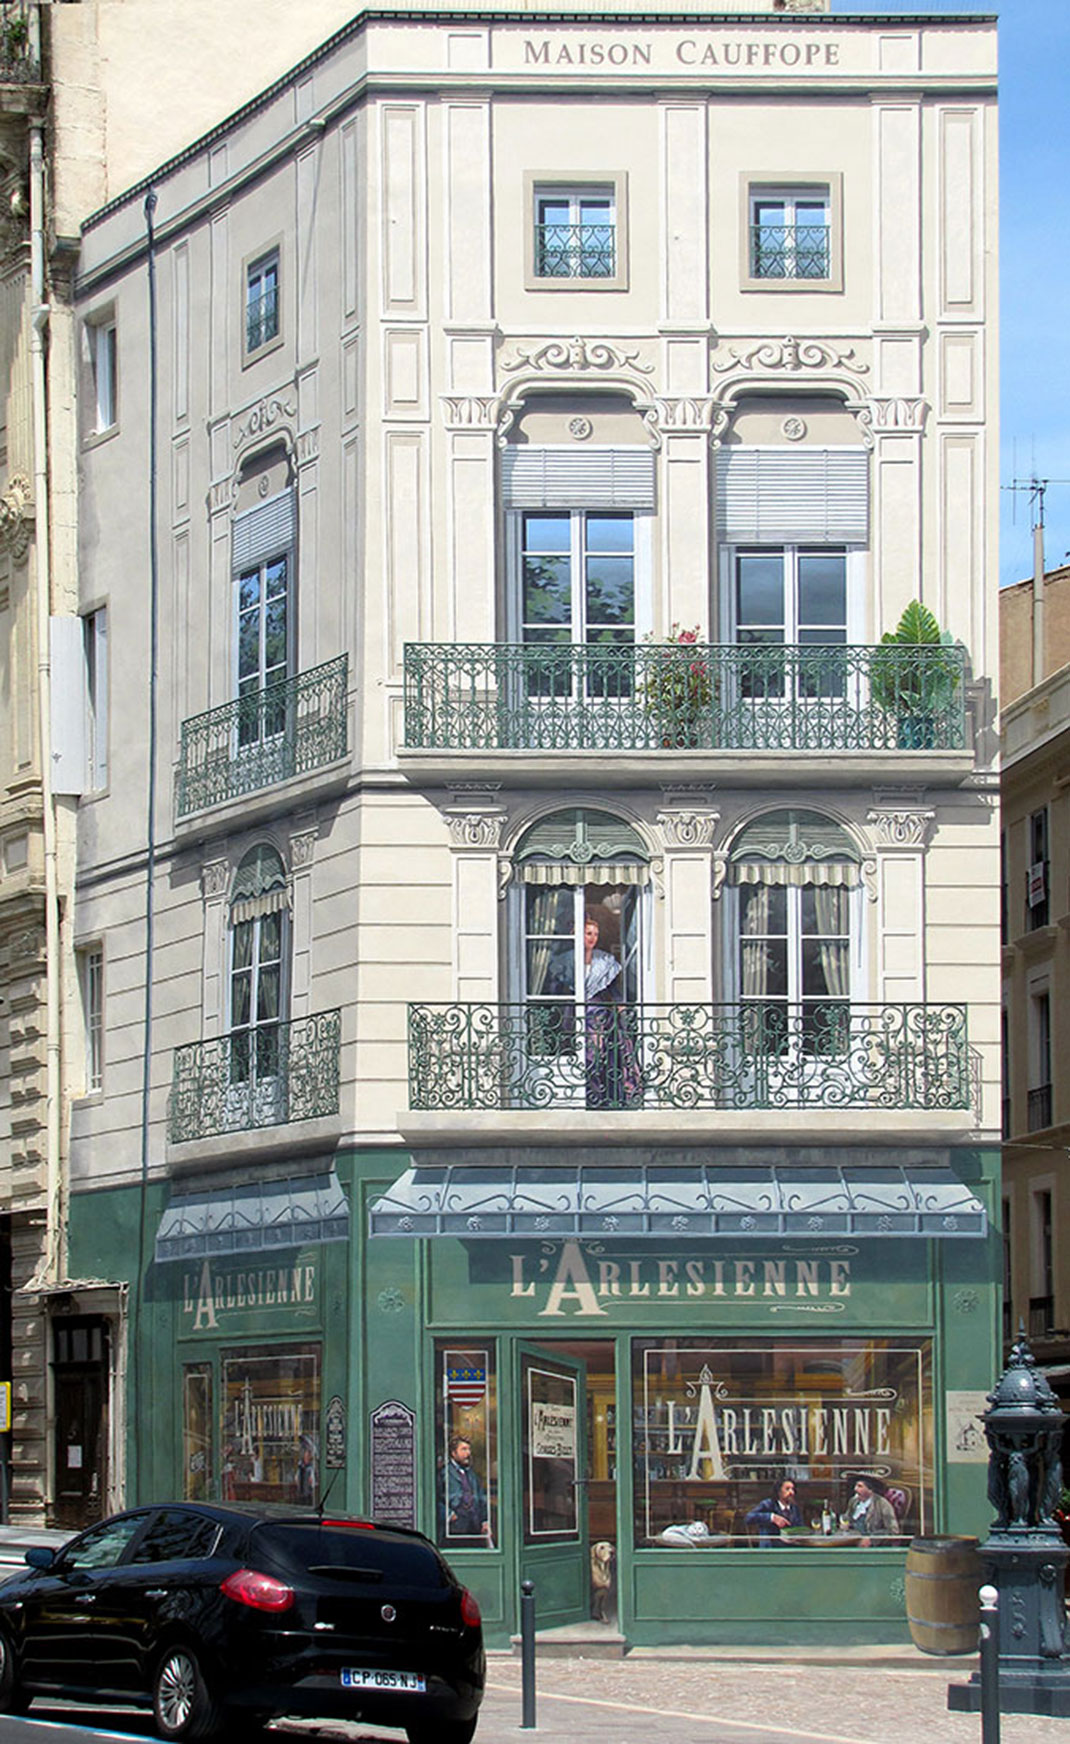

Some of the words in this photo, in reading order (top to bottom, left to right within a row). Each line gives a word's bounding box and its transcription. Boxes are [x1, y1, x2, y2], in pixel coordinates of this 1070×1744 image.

[523, 40, 653, 65] MAISON
[675, 39, 841, 66] CAUFFOPE
[183, 1259, 316, 1330] L'ARLESIENNE
[509, 1238, 852, 1316] L'ARLESIENNE
[666, 1384, 891, 1481] L'ARLESIENNE
